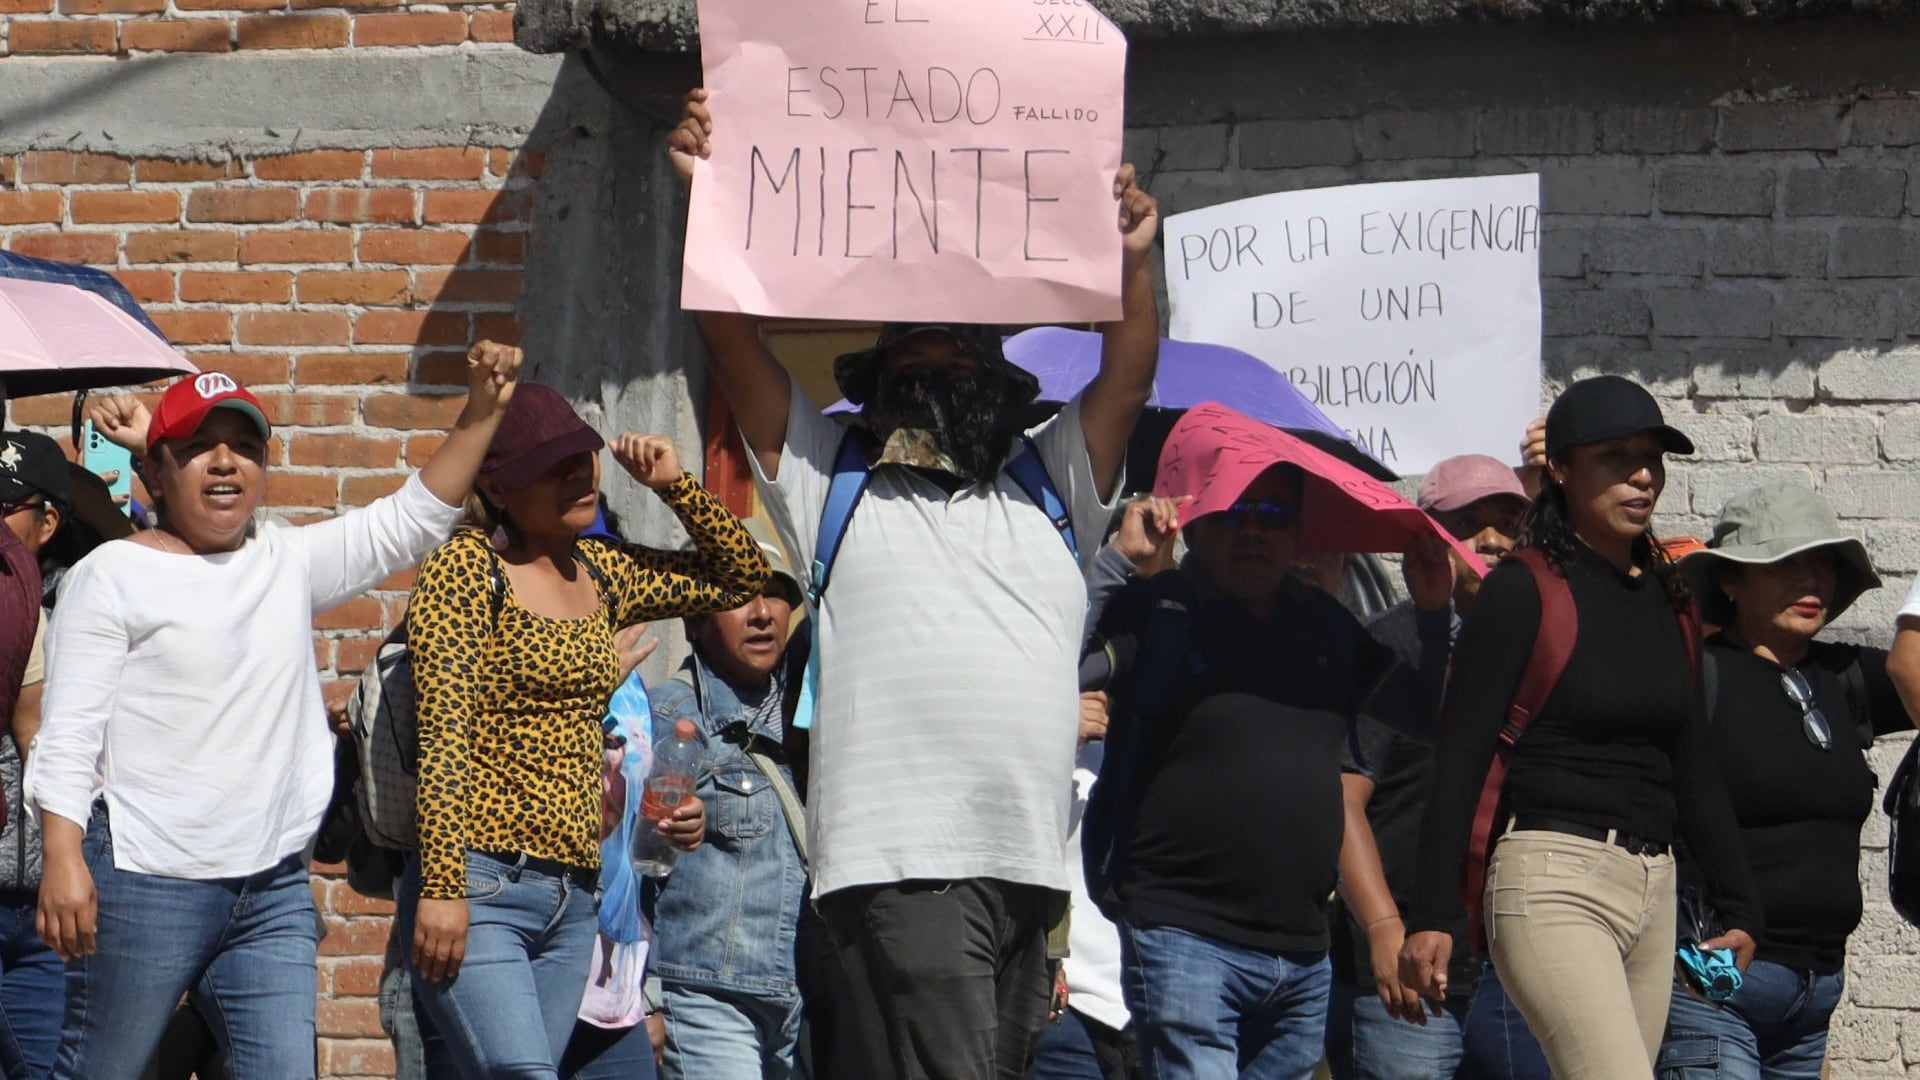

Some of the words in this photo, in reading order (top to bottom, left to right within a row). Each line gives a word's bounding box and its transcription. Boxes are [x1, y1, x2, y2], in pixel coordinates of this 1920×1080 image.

[1035, 13, 1100, 40] XXII
[787, 67, 1000, 125] ESTADO
[1013, 106, 1098, 122] FALLIDO
[745, 145, 1070, 261] MIENTE
[1180, 224, 1263, 280] POR
[1285, 216, 1329, 263] LA
[1360, 203, 1539, 259] EXIGENCIA
[1252, 290, 1314, 329] DE
[1360, 282, 1442, 320] UNA
[1283, 349, 1436, 406] BILACIÓN
